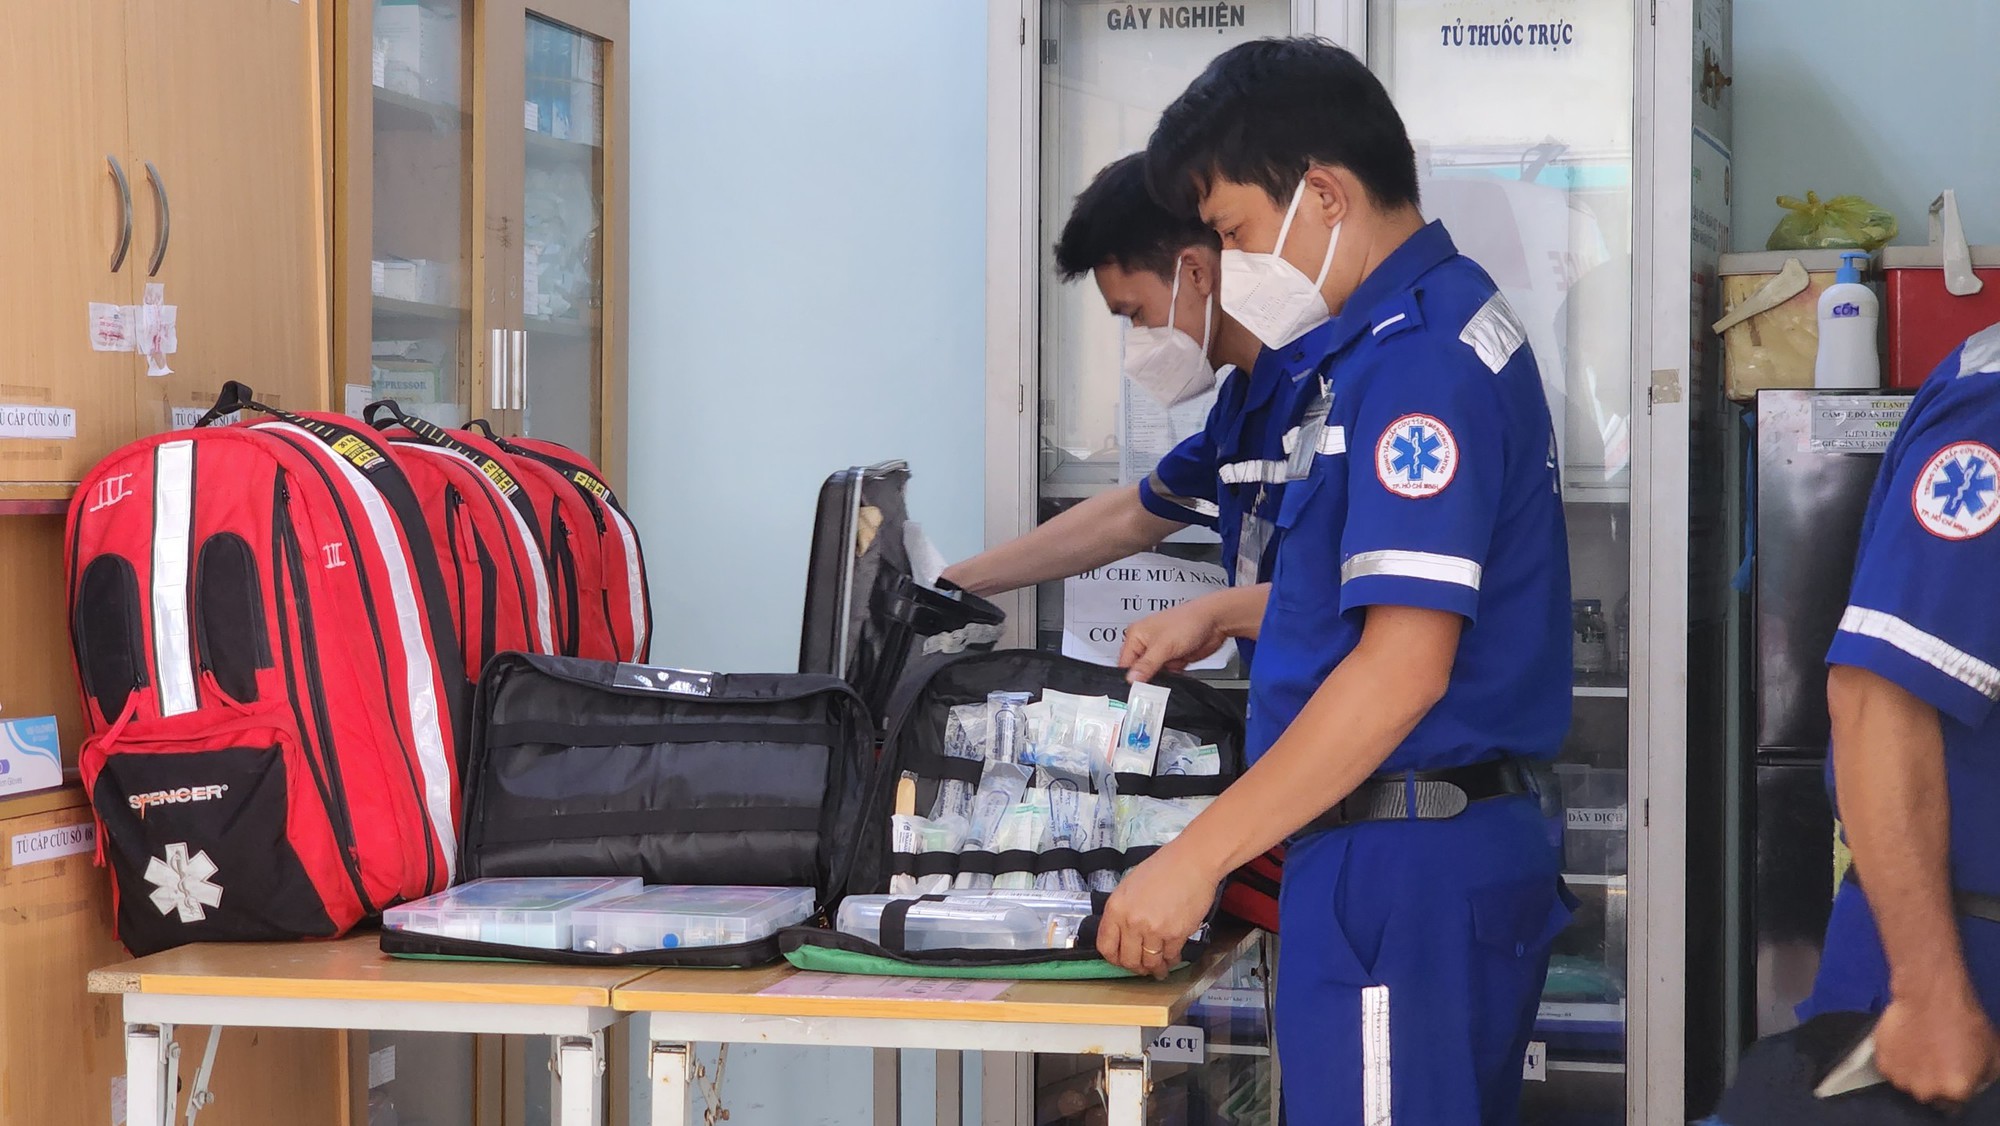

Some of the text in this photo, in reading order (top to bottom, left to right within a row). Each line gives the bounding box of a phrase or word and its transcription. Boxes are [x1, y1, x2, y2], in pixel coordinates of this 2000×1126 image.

[1107, 1, 1245, 34] GÂY NGHIỆN
[1441, 16, 1573, 51] TỦ THUỐC TRỰC
[63, 413, 71, 427] 07
[1106, 567, 1141, 582] CHE
[1146, 567, 1186, 583] MƯA
[1120, 595, 1142, 611] TỦ
[1089, 626, 1118, 643] CƠ
[128, 784, 224, 811] SPENCER
[1176, 1036, 1199, 1052] CỤ
